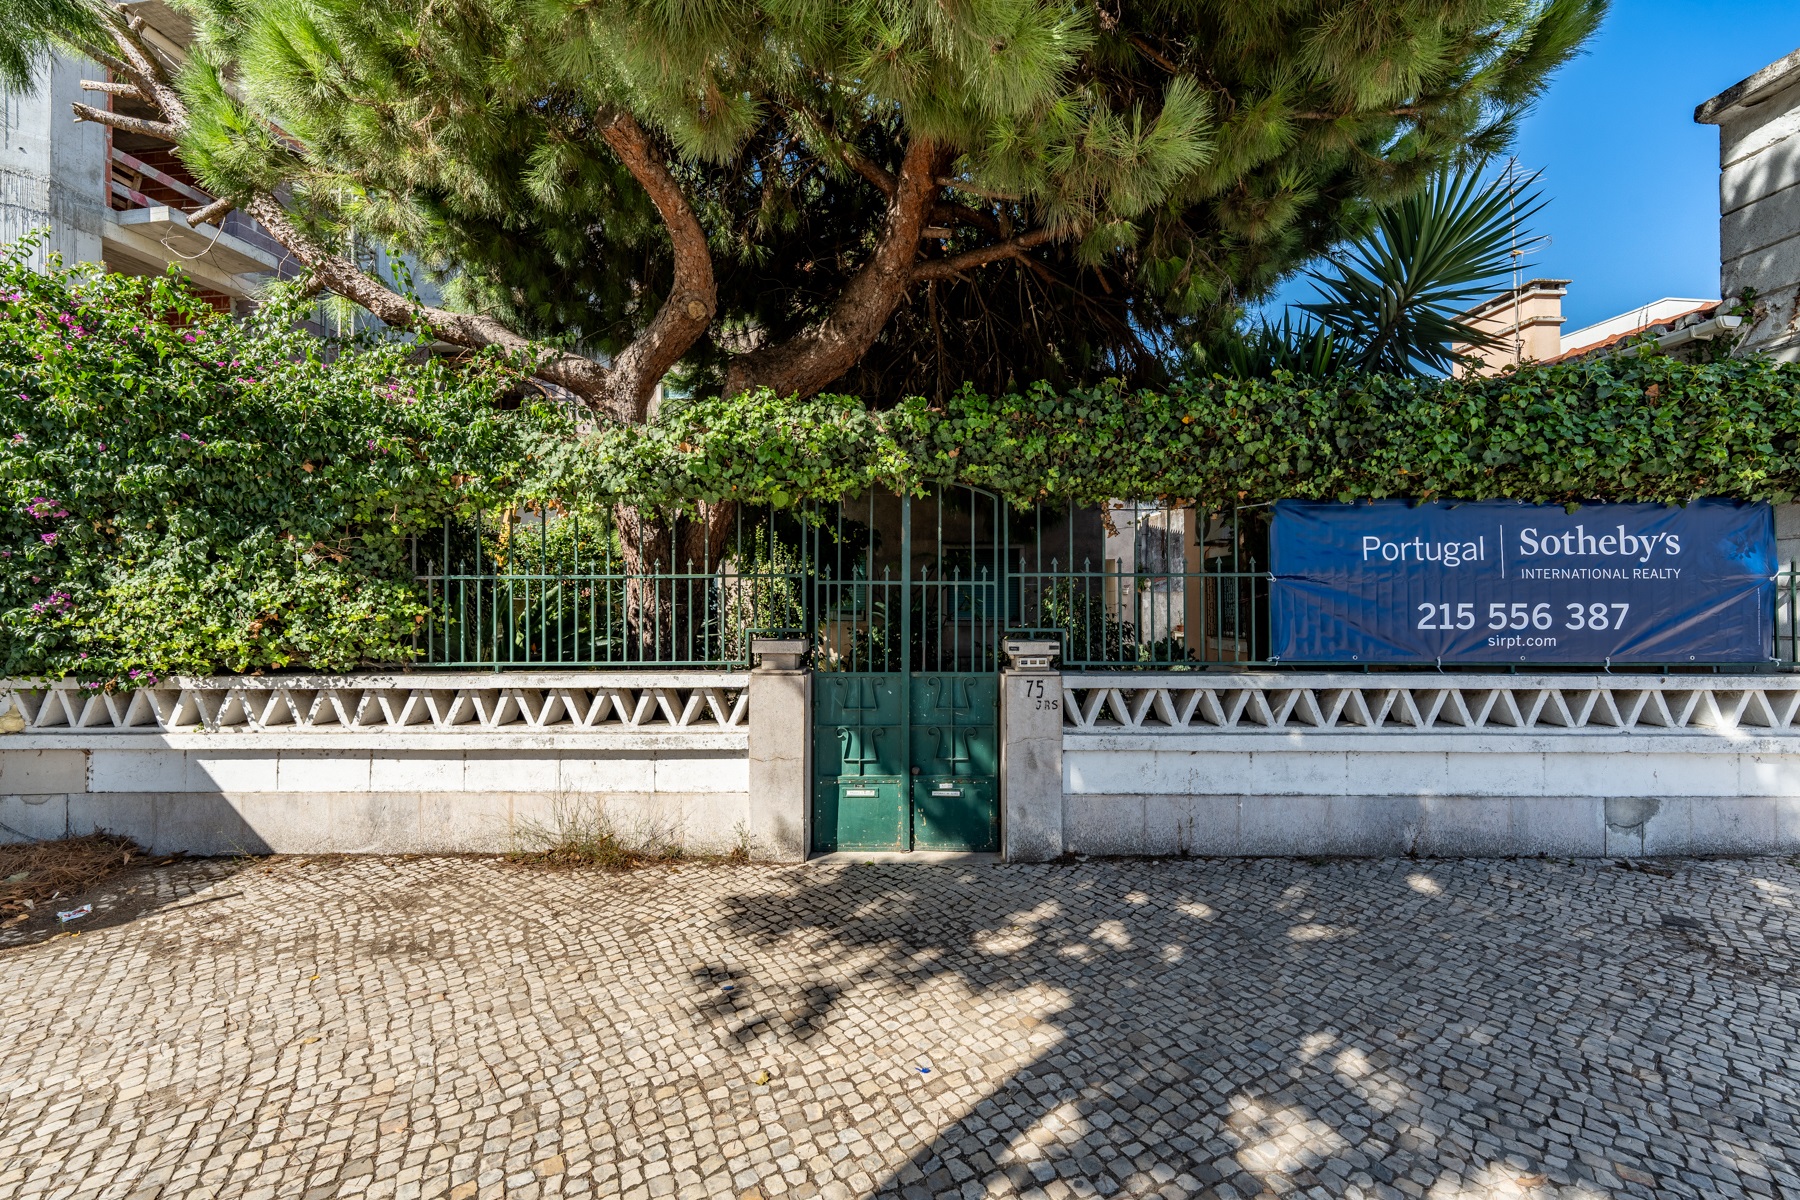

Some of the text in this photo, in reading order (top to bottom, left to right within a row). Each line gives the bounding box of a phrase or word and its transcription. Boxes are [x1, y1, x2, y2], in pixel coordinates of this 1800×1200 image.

[1362, 524, 1681, 567] Portugal Sotheby's
[1521, 568, 1682, 580] INTERNATIONAL REALTY
[1417, 602, 1630, 631] 215 556 387
[1487, 634, 1557, 649] sirpt.com
[1026, 680, 1044, 699] 75
